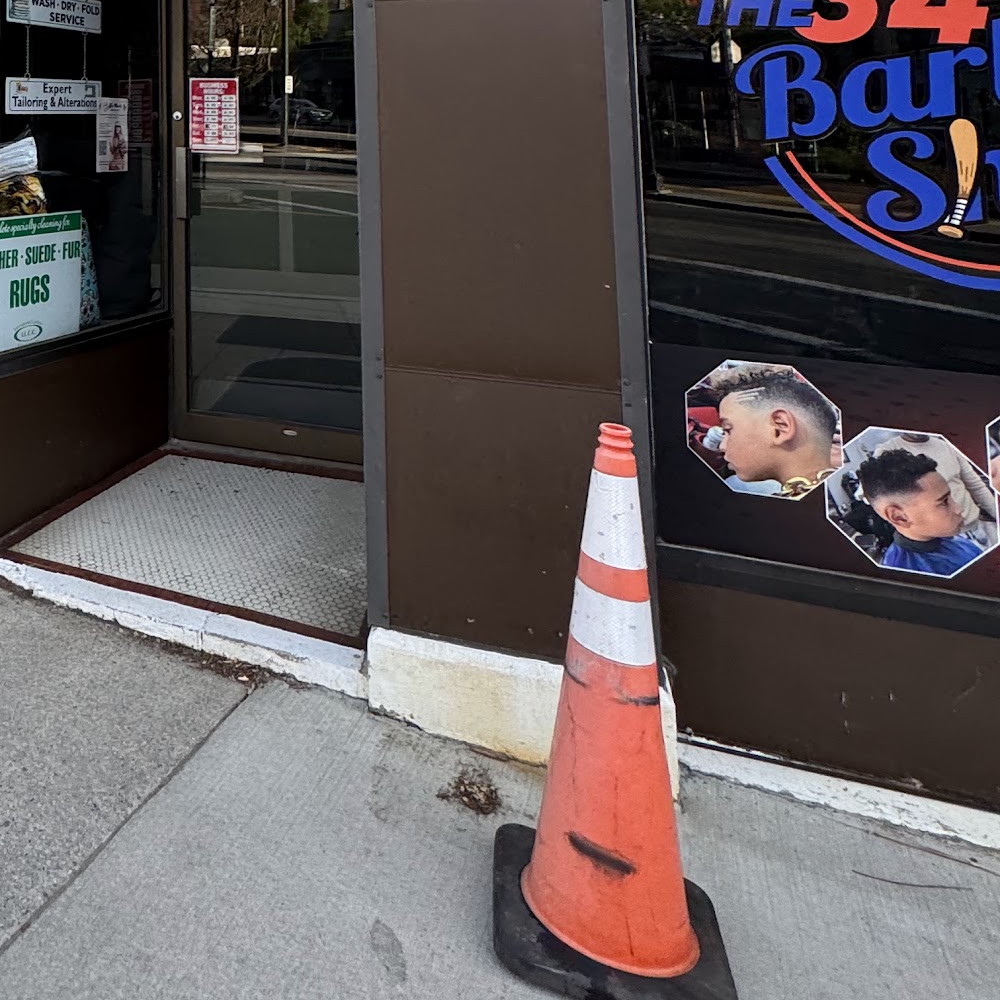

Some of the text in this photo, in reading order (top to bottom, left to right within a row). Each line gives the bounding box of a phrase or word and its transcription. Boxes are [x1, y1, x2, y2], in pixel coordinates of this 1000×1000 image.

[61, 0, 77, 12] DRY
[81, 4, 100, 16] FOLD
[49, 12, 85, 26] SERVICE
[735, 18, 1000, 141] Bar
[43, 83, 72, 96] Expert
[12, 96, 48, 110] Tailoring
[50, 98, 56, 108] &
[58, 96, 97, 108] Alterations
[10, 218, 37, 236] specialty
[37, 216, 62, 231] cleaning
[25, 243, 56, 265] SUEDE
[63, 240, 81, 260] FUR
[10, 274, 50, 309] RUGS
